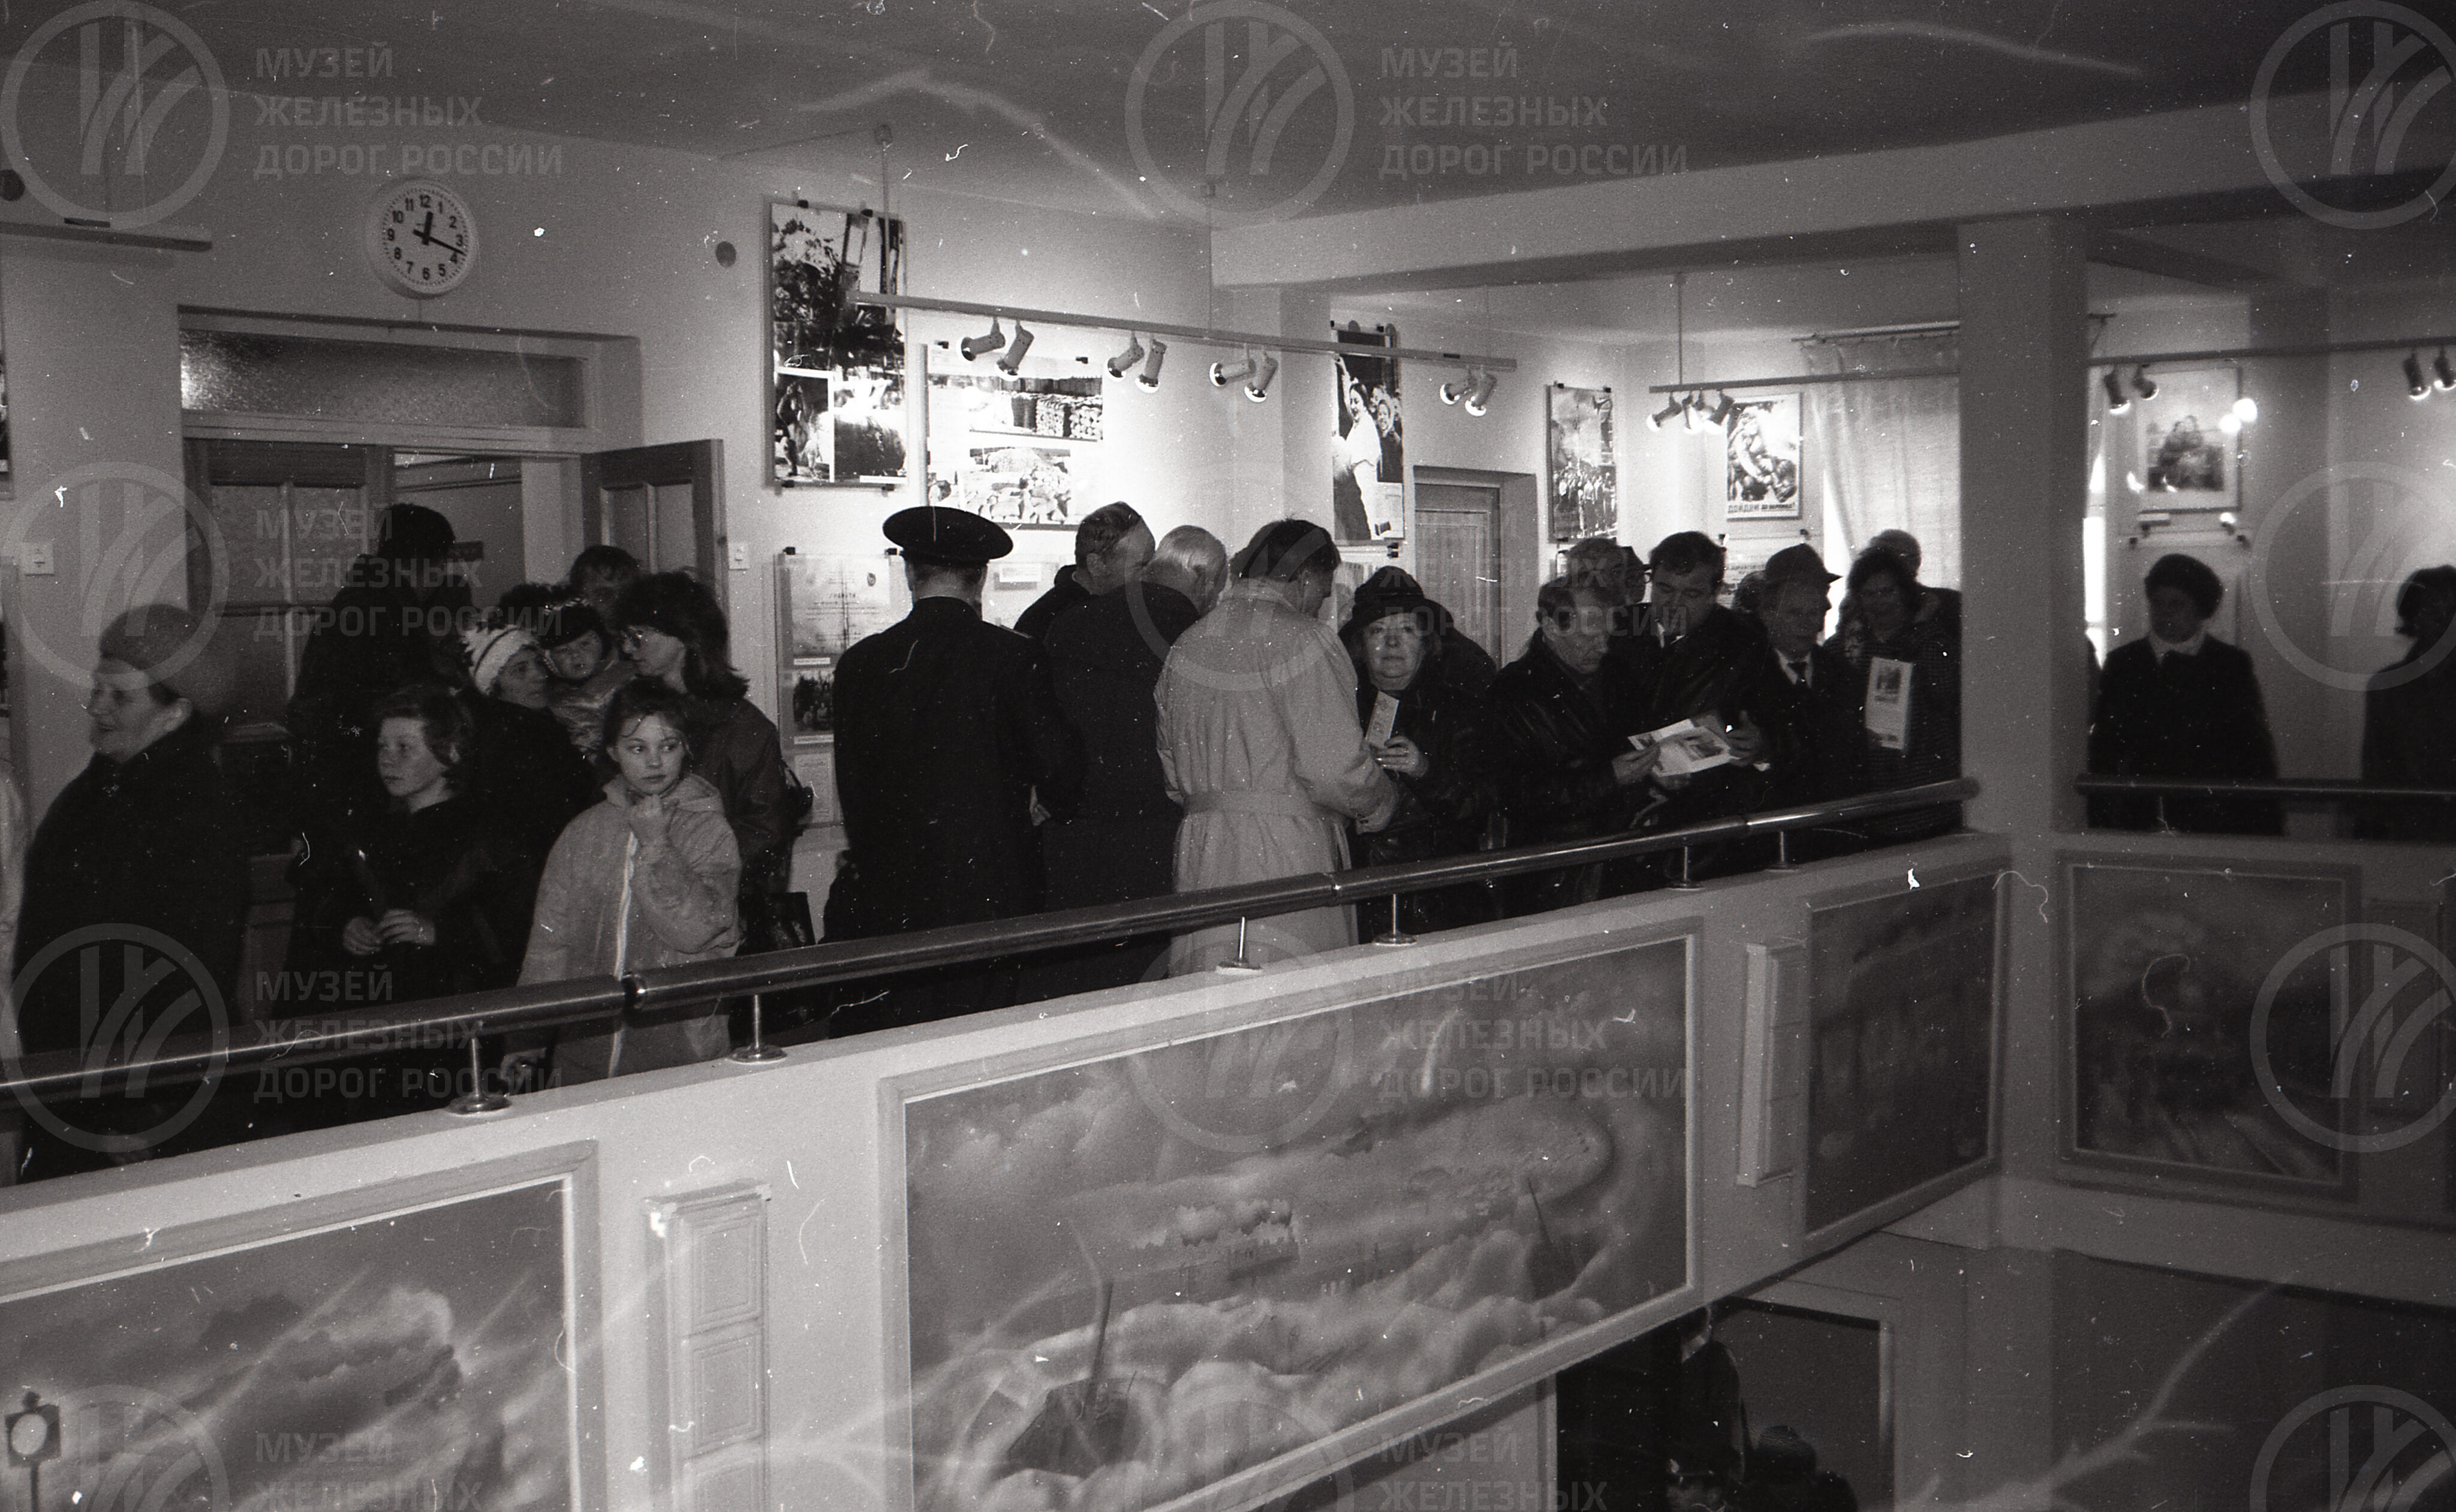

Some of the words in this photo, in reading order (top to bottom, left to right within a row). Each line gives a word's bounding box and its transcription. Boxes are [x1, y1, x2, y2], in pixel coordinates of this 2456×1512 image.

[405, 198, 413, 211] 11
[420, 195, 431, 207] 12
[439, 201, 443, 213] 1
[392, 211, 404, 224] 10
[449, 216, 456, 228] 2
[387, 228, 395, 241] 9
[456, 234, 463, 246] 3
[395, 248, 401, 260] 8
[450, 252, 458, 264] 4
[407, 261, 413, 273] 7
[438, 264, 446, 276] 5
[423, 268, 430, 280] 6
